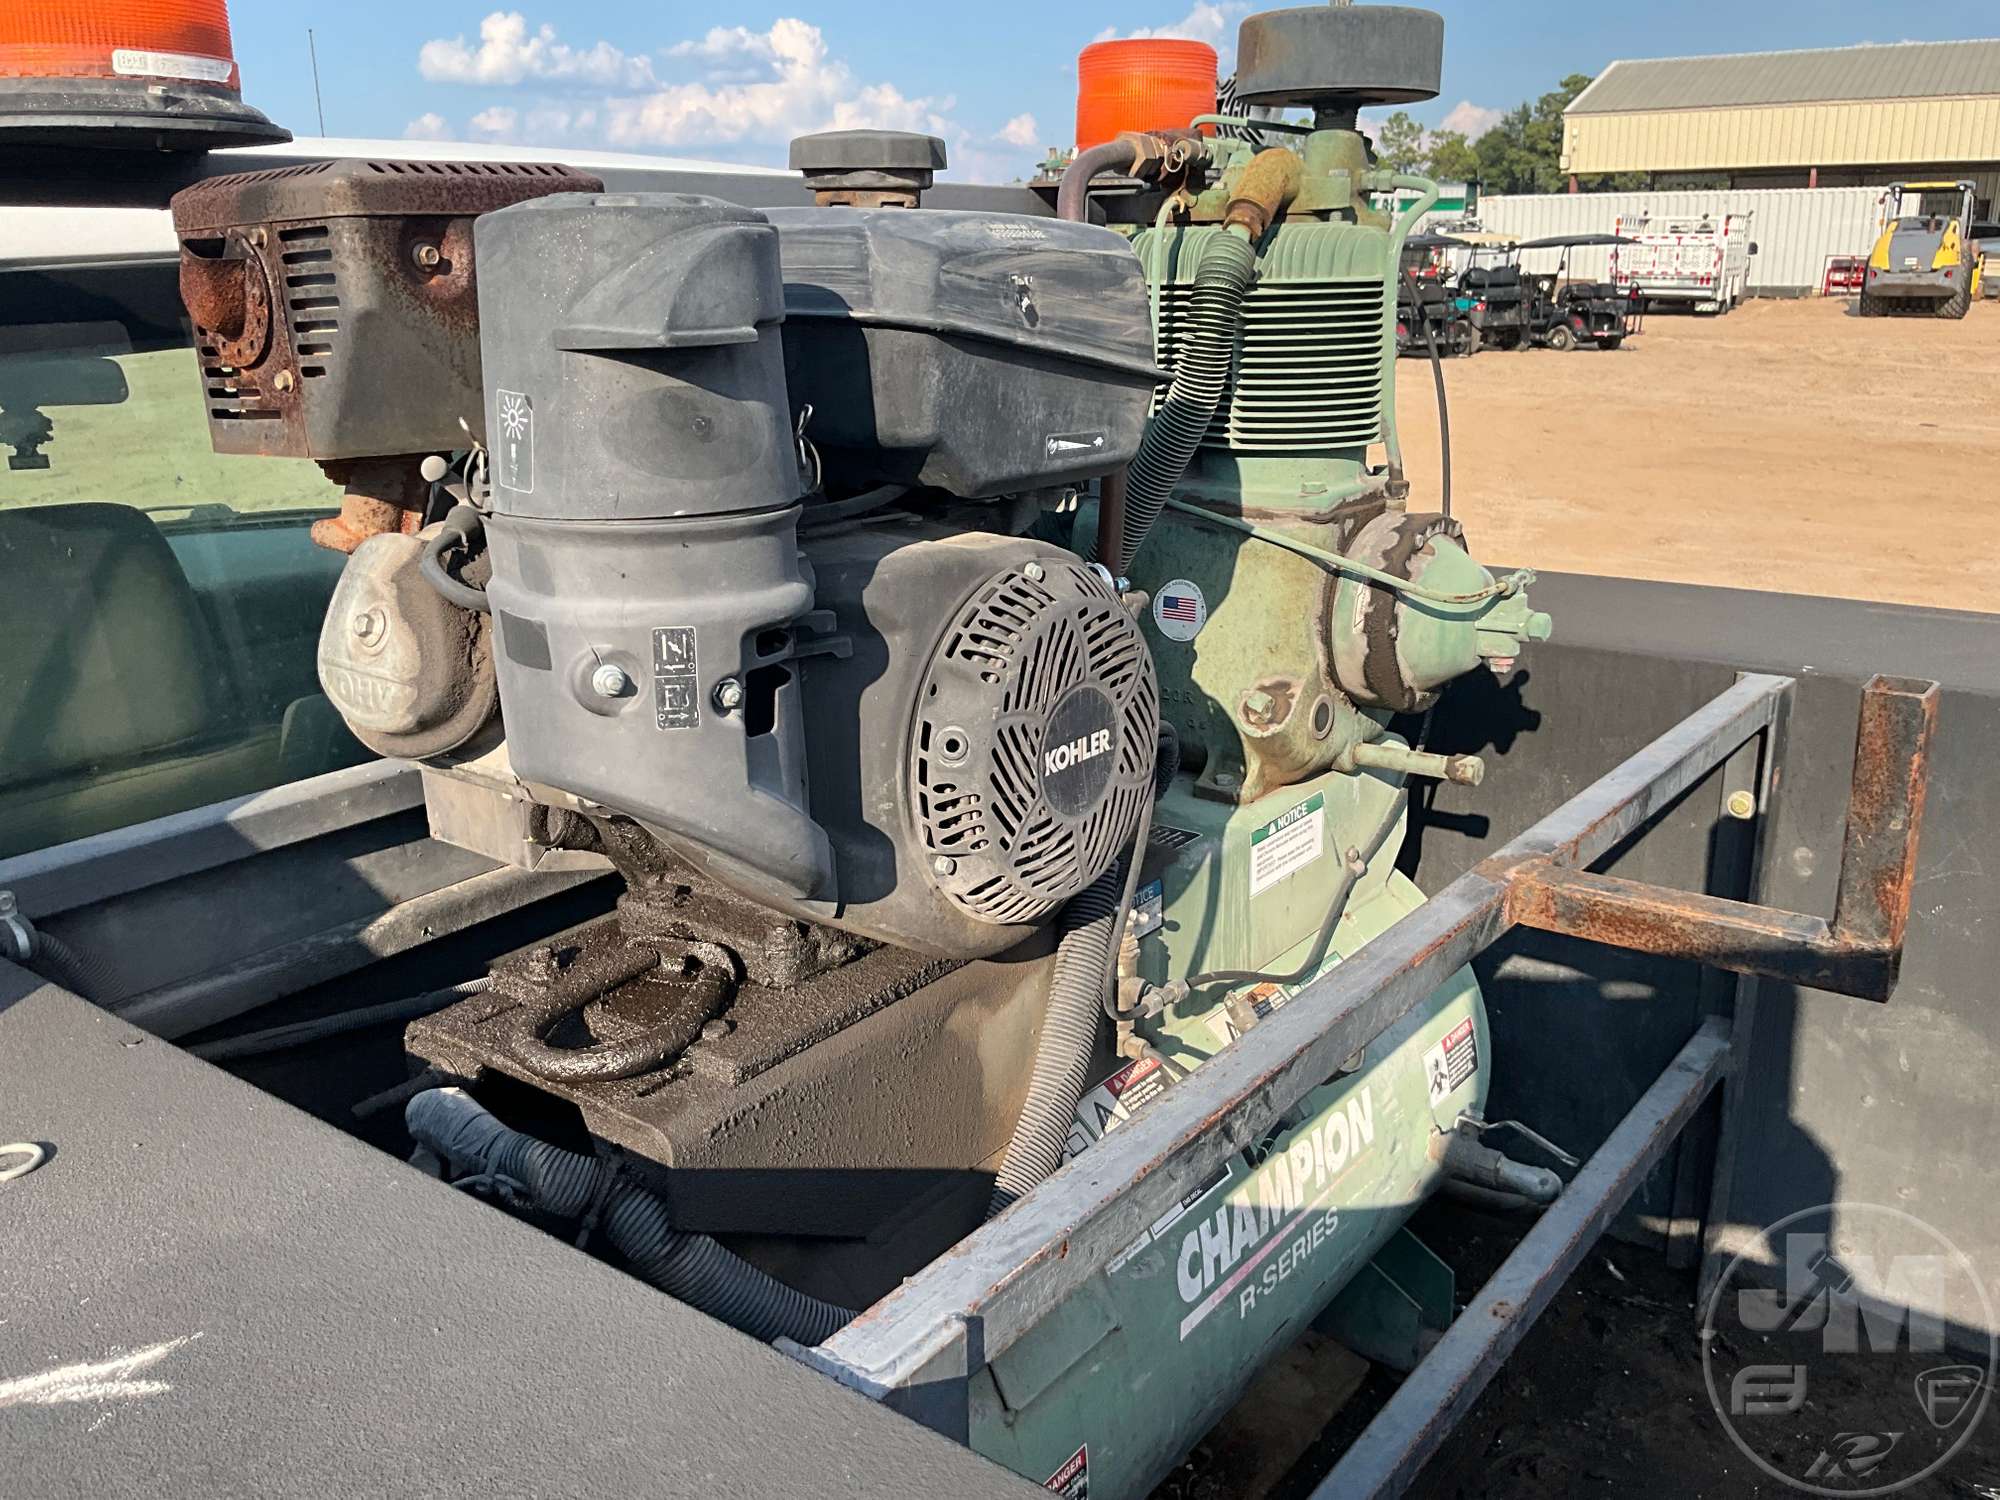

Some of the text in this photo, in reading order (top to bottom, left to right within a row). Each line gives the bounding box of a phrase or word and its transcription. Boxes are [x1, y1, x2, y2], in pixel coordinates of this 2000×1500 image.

[1044, 728, 1111, 777] KOHLER
[1277, 802, 1308, 830] NOTICE
[1120, 1057, 1155, 1082] DANGER
[1177, 1086, 1375, 1303] CHAMPION
[1239, 1206, 1339, 1320] R-SERIES
